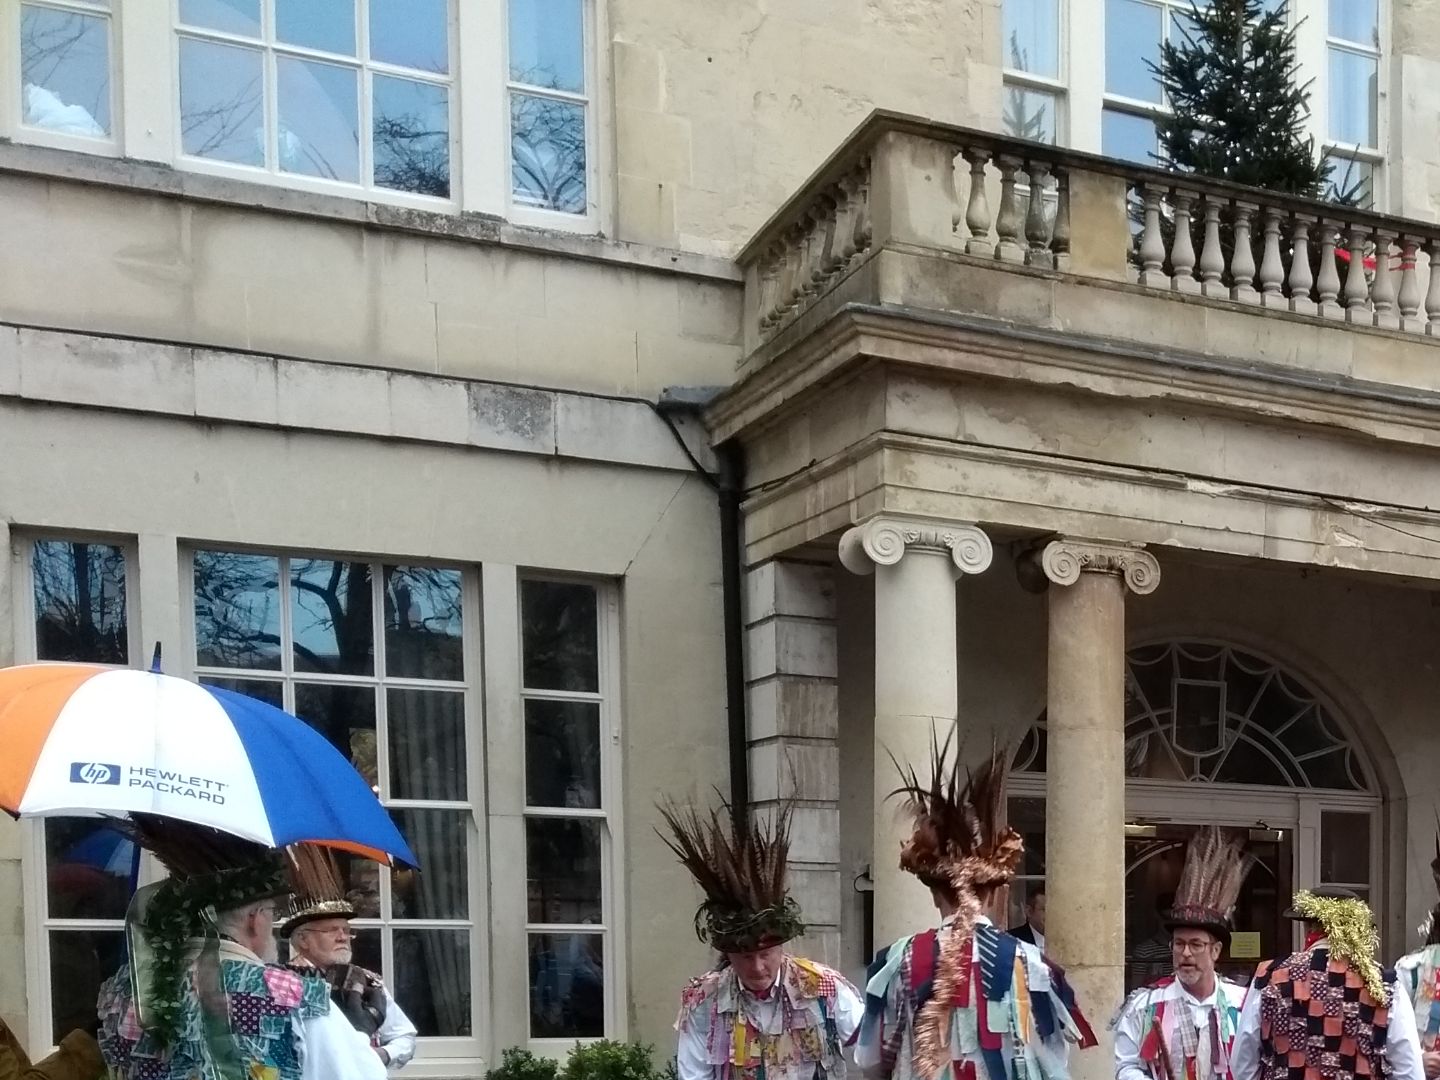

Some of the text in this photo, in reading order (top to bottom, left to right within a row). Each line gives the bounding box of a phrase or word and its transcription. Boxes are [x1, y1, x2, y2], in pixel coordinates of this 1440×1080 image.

[82, 762, 109, 784] hp
[129, 766, 226, 792] HEWLETT
[128, 778, 225, 805] PACKARD
